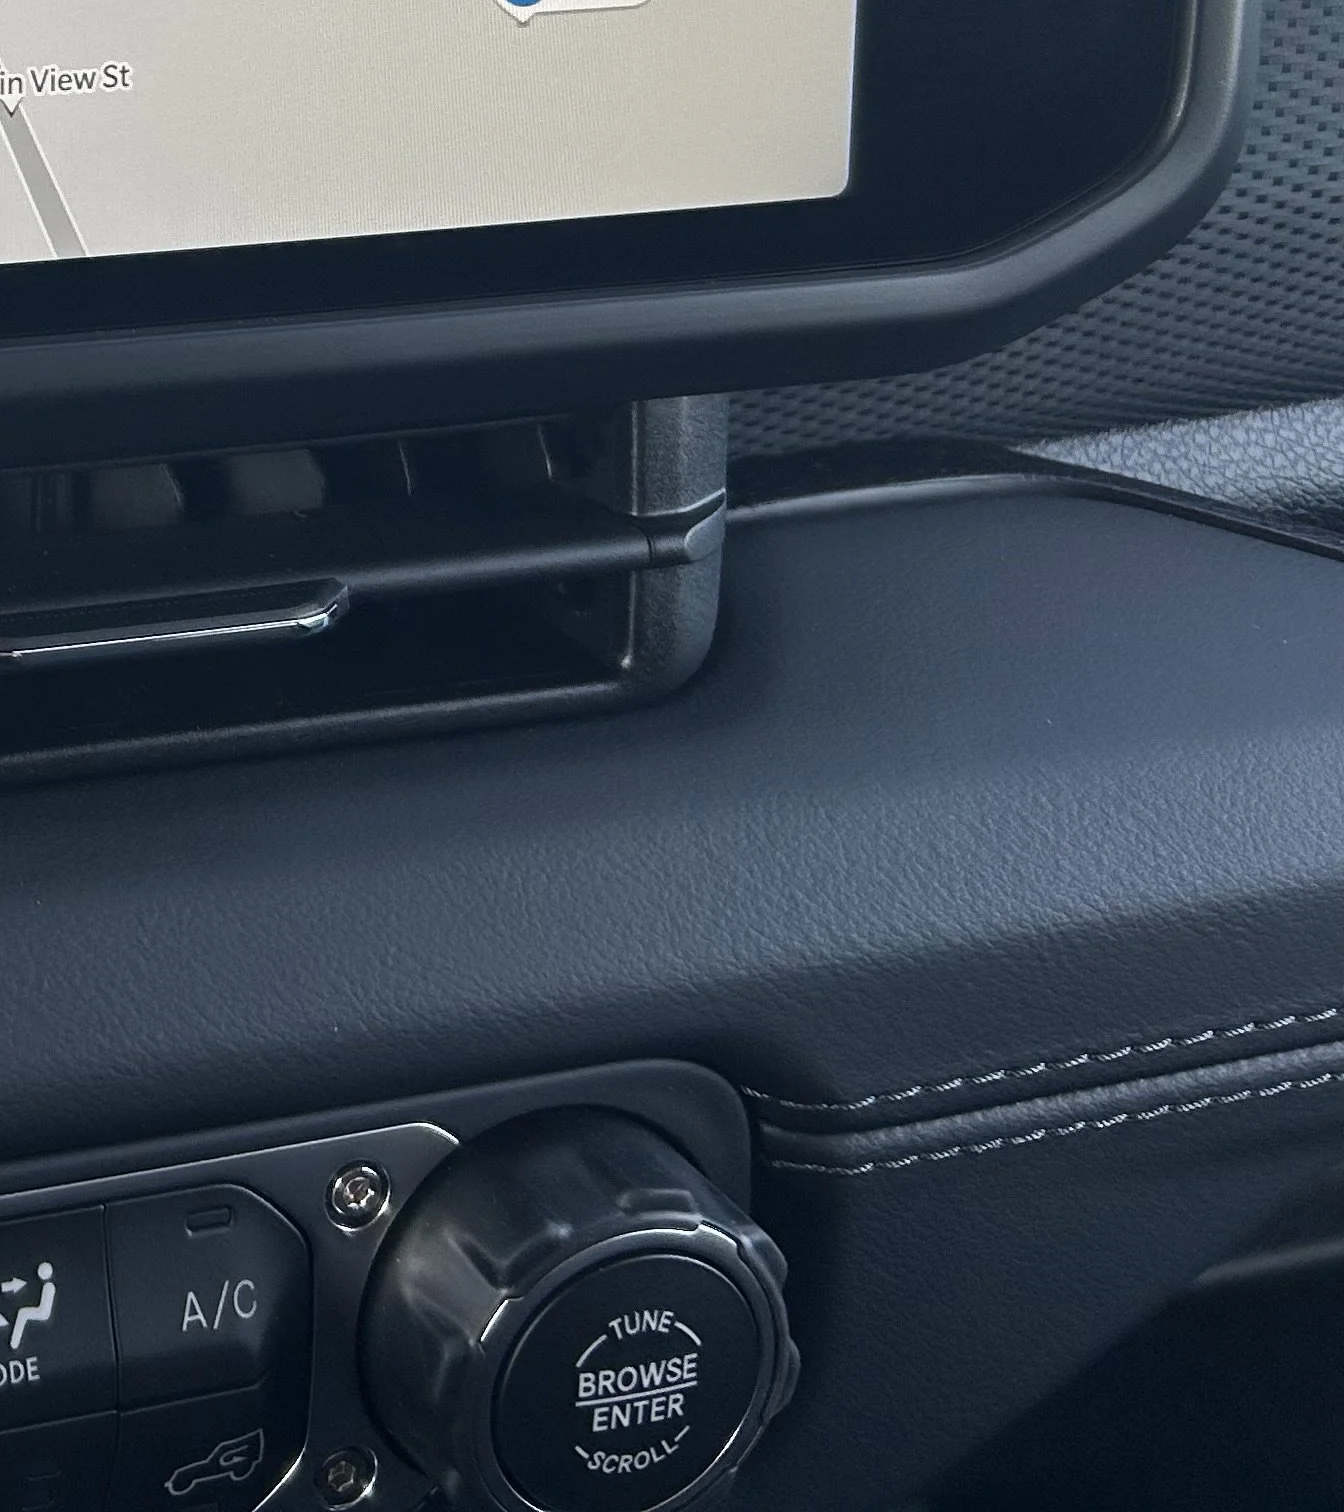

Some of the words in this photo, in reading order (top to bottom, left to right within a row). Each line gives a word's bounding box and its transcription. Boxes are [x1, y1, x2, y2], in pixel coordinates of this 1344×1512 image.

[30, 67, 98, 94] View
[103, 62, 131, 89] St
[182, 1279, 257, 1331] A/C
[609, 1310, 674, 1340] TUNE
[577, 1352, 698, 1398] BROWSE
[593, 1394, 684, 1432] ENTER
[587, 1440, 679, 1474] SCROLL
